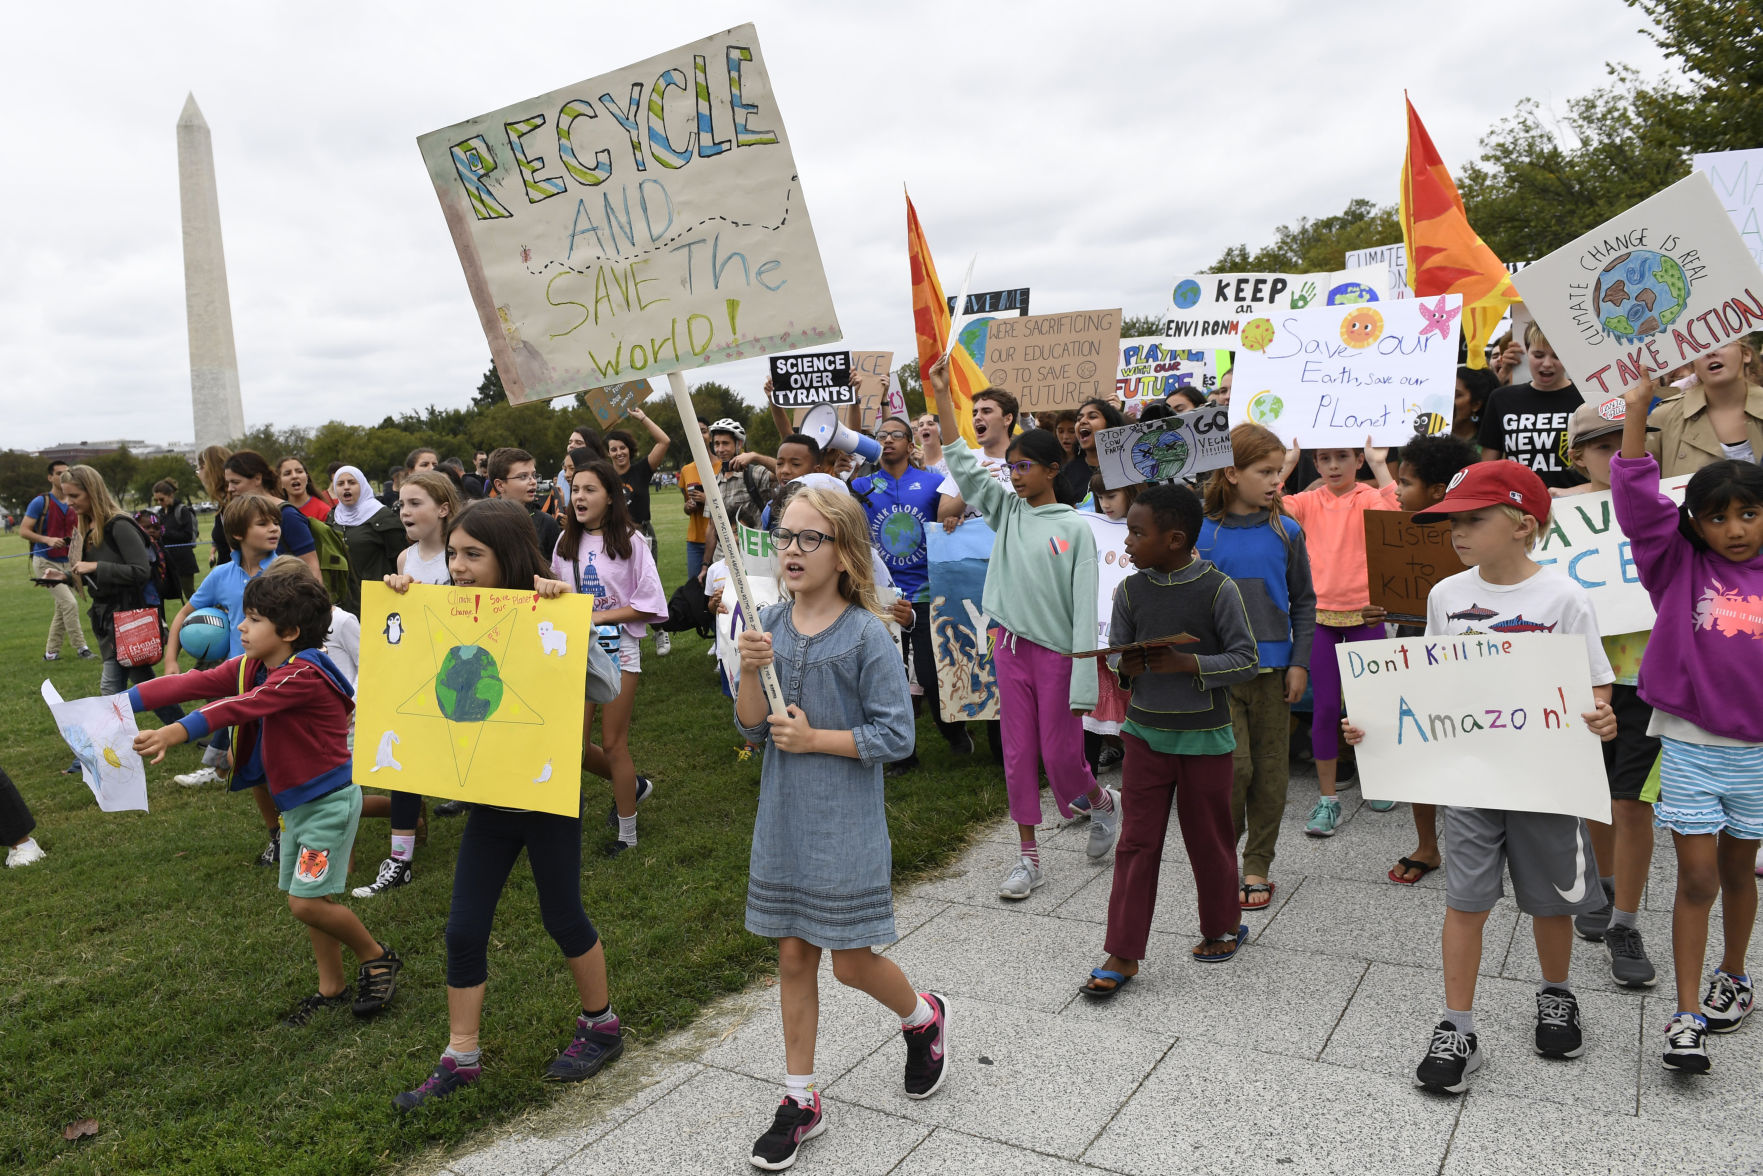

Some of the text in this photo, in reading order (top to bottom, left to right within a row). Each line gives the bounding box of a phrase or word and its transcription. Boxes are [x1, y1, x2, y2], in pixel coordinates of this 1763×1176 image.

[449, 45, 779, 221] RECYCLE
[567, 178, 675, 260] AND
[1580, 228, 1649, 272] CHANGE
[1660, 234, 1681, 252] IS
[1679, 249, 1709, 287] REAL
[546, 232, 788, 339] SAVE The
[1215, 278, 1287, 304] KEEP
[998, 289, 1028, 310] ME
[1236, 303, 1253, 313] an
[1024, 314, 1113, 338] SACRIFICING
[1569, 282, 1605, 346] CLIMATE
[1268, 317, 1362, 359] Save
[1586, 288, 1763, 393] TAKE ACTION
[990, 340, 1101, 363] OUR EDUCATION
[1123, 343, 1205, 367] PLAYING
[776, 355, 846, 374] SCIENCE
[1013, 364, 1072, 383] TO SAVE
[1121, 361, 1181, 377] WITH OUR
[790, 372, 833, 389] OVER
[1116, 372, 1193, 399] FUTURE
[775, 386, 850, 404] TYRANTS
[1193, 411, 1229, 435] GO
[1099, 428, 1126, 443] STOP
[1198, 433, 1230, 448] VEGAN
[1505, 431, 1556, 452] NEW
[872, 504, 927, 536] THINK GLOBAL
[1541, 500, 1611, 552] AV
[892, 543, 927, 566] LOCALLY
[1406, 553, 1436, 577] to
[1348, 640, 1512, 678] Don't Kill the
[1397, 686, 1571, 746] Amazon!
